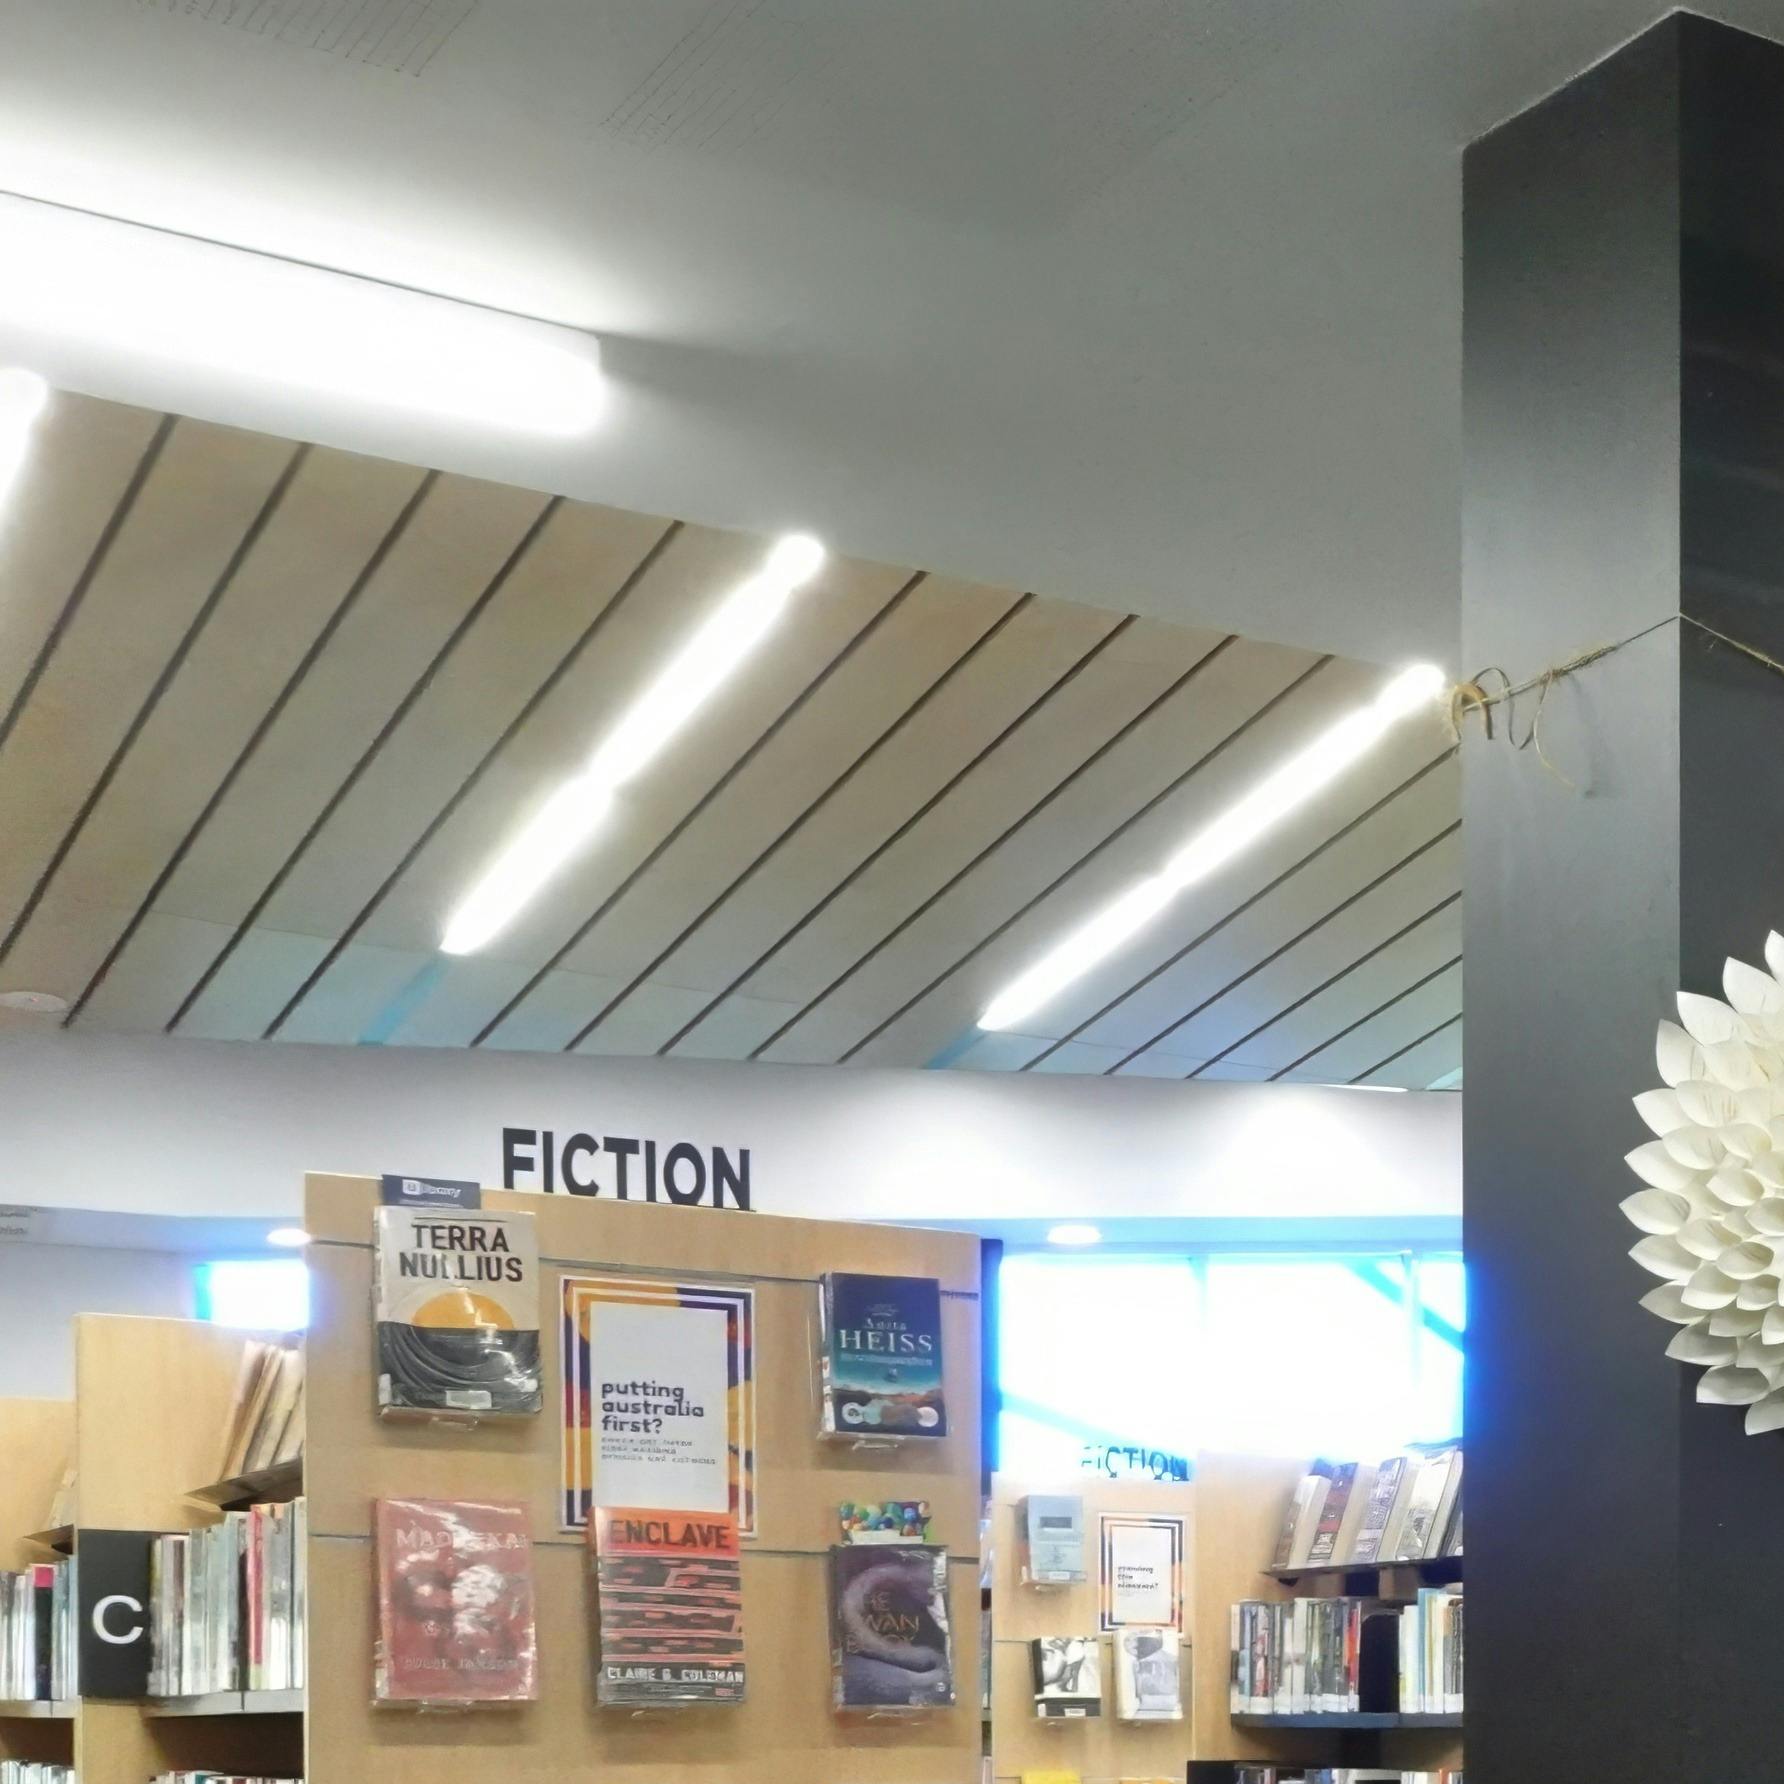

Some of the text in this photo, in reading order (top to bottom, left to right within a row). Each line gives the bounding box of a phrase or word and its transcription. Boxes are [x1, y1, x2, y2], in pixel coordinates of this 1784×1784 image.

[502, 1127, 752, 1211] FICTION
[411, 1224, 510, 1252] TERRA
[840, 1329, 932, 1353] HEISS
[602, 1380, 684, 1401] putting
[602, 1400, 704, 1417] australia
[602, 1415, 663, 1434] first?
[609, 1520, 731, 1549] ENCLAVE
[91, 1595, 144, 1644] C
